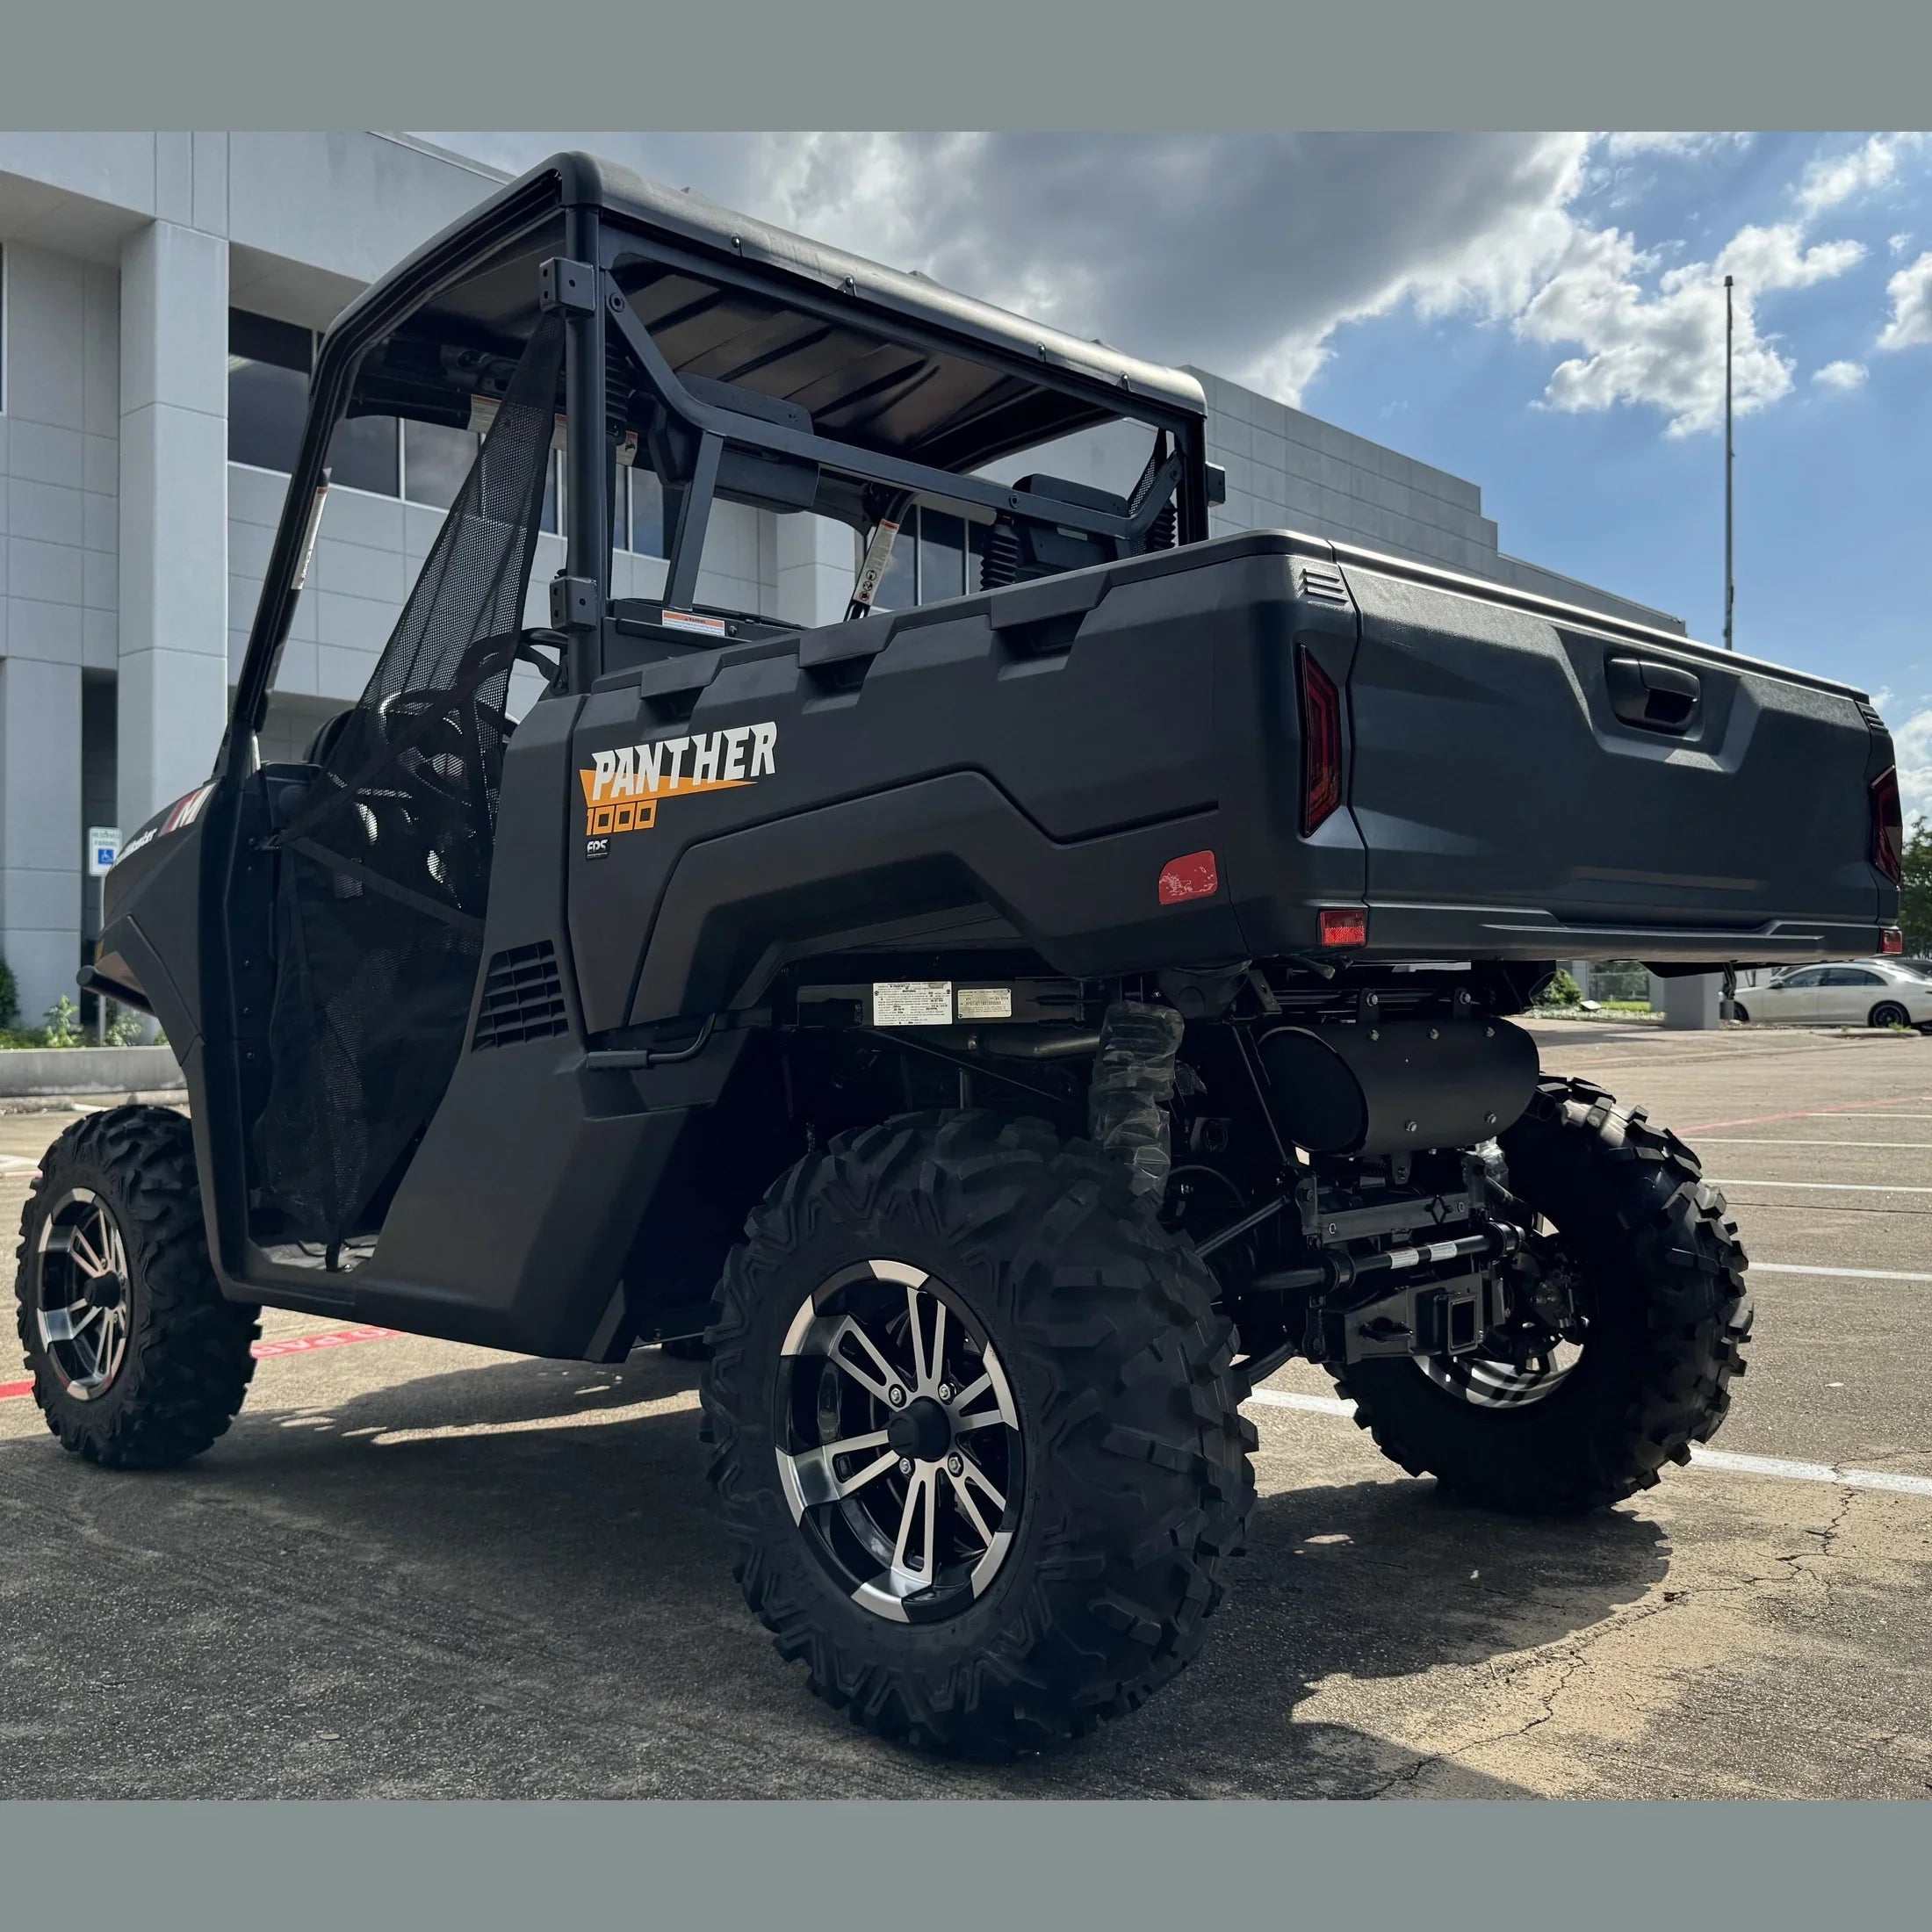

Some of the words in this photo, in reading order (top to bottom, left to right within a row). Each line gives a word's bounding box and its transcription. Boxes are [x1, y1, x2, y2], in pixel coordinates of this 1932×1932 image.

[592, 721, 777, 801] PANTHER
[586, 799, 657, 836] 1000
[587, 839, 609, 853] EPS
